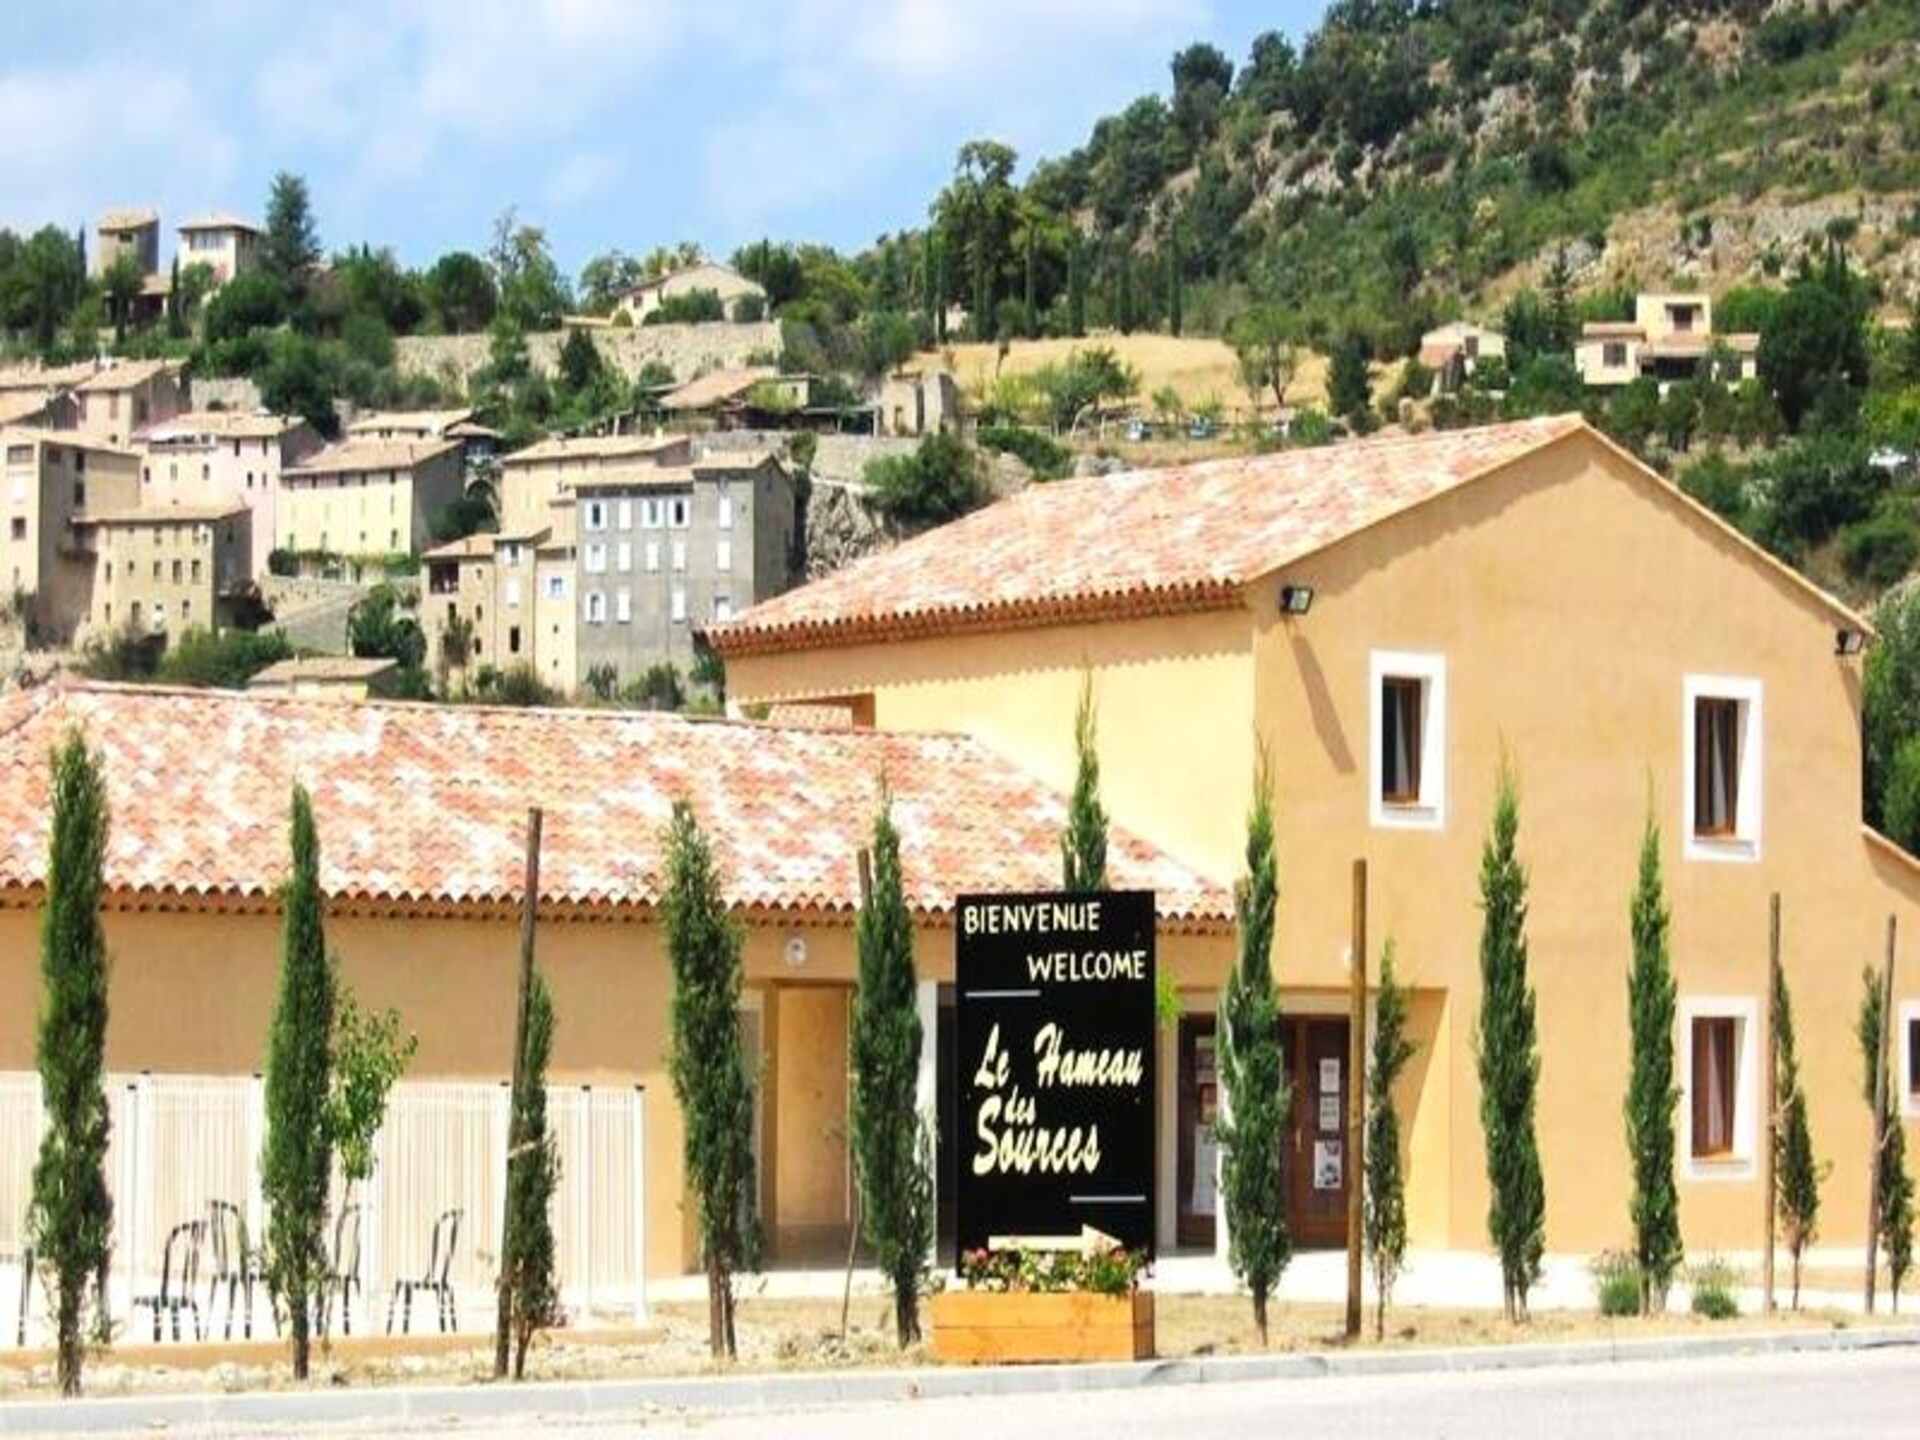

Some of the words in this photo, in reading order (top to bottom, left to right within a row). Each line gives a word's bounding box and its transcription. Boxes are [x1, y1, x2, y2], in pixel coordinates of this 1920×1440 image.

[963, 902, 1101, 935] BIENVENUE
[1026, 950, 1147, 983] WELCOME
[974, 1022, 1010, 1088] Le
[1033, 1022, 1143, 1089] Hameau
[1004, 1085, 1036, 1126] des
[972, 1095, 1101, 1177] Sources
